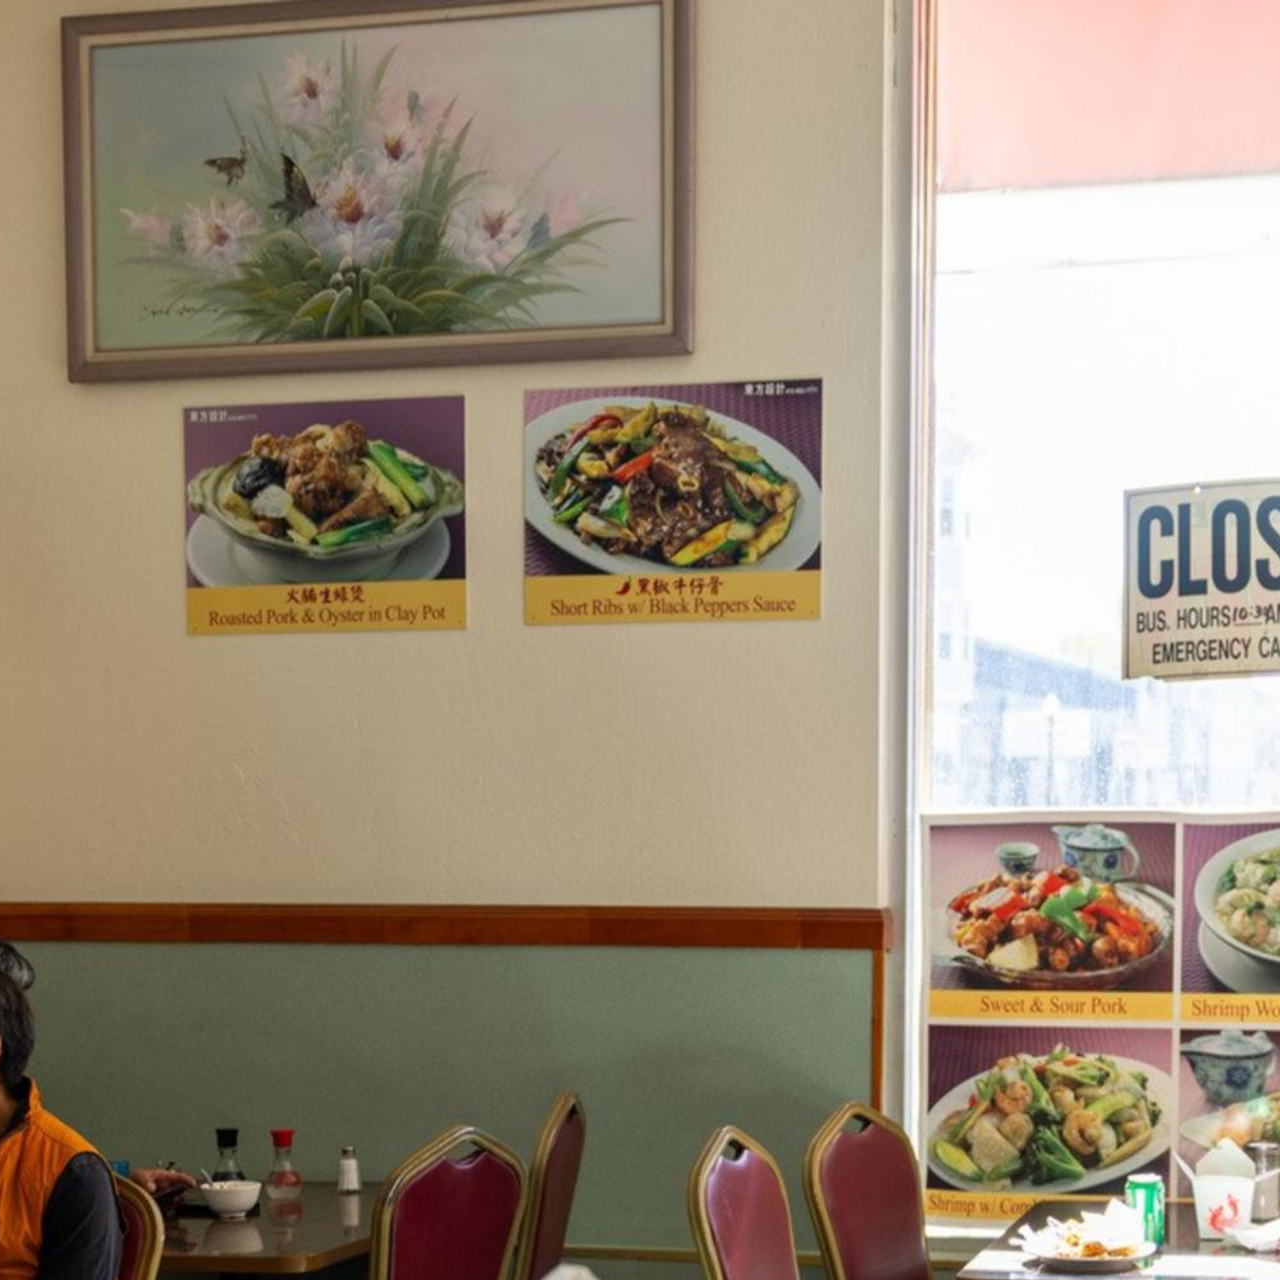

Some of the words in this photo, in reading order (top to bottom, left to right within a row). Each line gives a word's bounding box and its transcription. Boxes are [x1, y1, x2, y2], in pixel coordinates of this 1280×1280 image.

[208, 609, 262, 626] Roasted
[266, 608, 297, 625] Pork
[301, 608, 315, 623] &
[318, 607, 363, 626] Oyster
[369, 606, 382, 621] in
[385, 605, 417, 624] Clay
[422, 605, 446, 620] Pot
[551, 599, 588, 617] Short
[592, 599, 623, 615] Ribs
[628, 600, 644, 614] w/
[649, 598, 688, 614] Black
[694, 597, 749, 618] Peppers
[753, 594, 796, 613] Sauce
[1136, 610, 1170, 633] BUS.
[1177, 605, 1231, 630] HOURS
[1152, 638, 1251, 664] EMERGENCY
[980, 995, 1025, 1014] Sweet
[1030, 997, 1044, 1013] &
[1050, 997, 1085, 1014] Sour
[1091, 997, 1127, 1015] Pork
[1191, 1000, 1250, 1022] Shrimp
[929, 1194, 975, 1217] Shrimp
